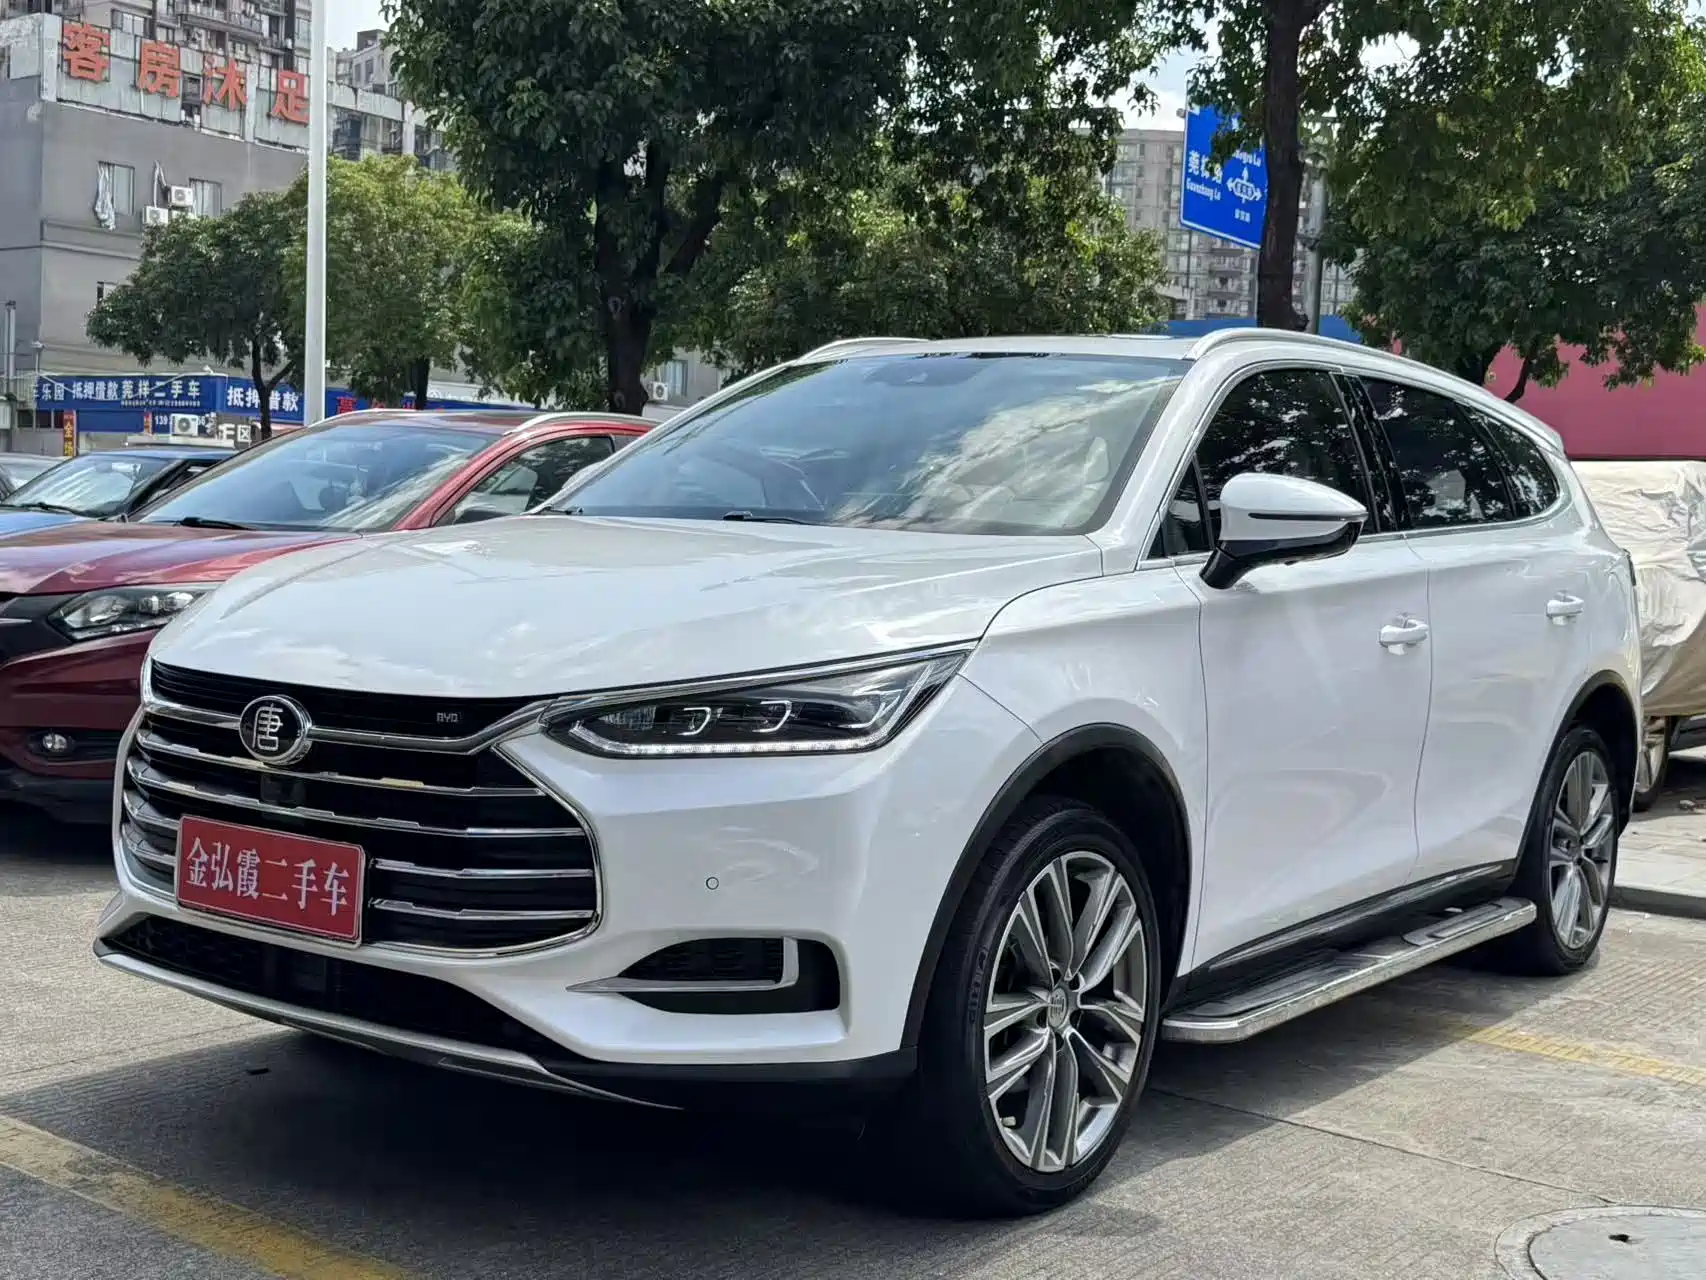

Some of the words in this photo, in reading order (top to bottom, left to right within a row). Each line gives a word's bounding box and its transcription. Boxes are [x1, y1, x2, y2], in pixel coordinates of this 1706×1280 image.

[252, 703, 284, 751] 唐
[436, 712, 459, 722] BYD
[184, 836, 351, 917] 金弘霞二手车
